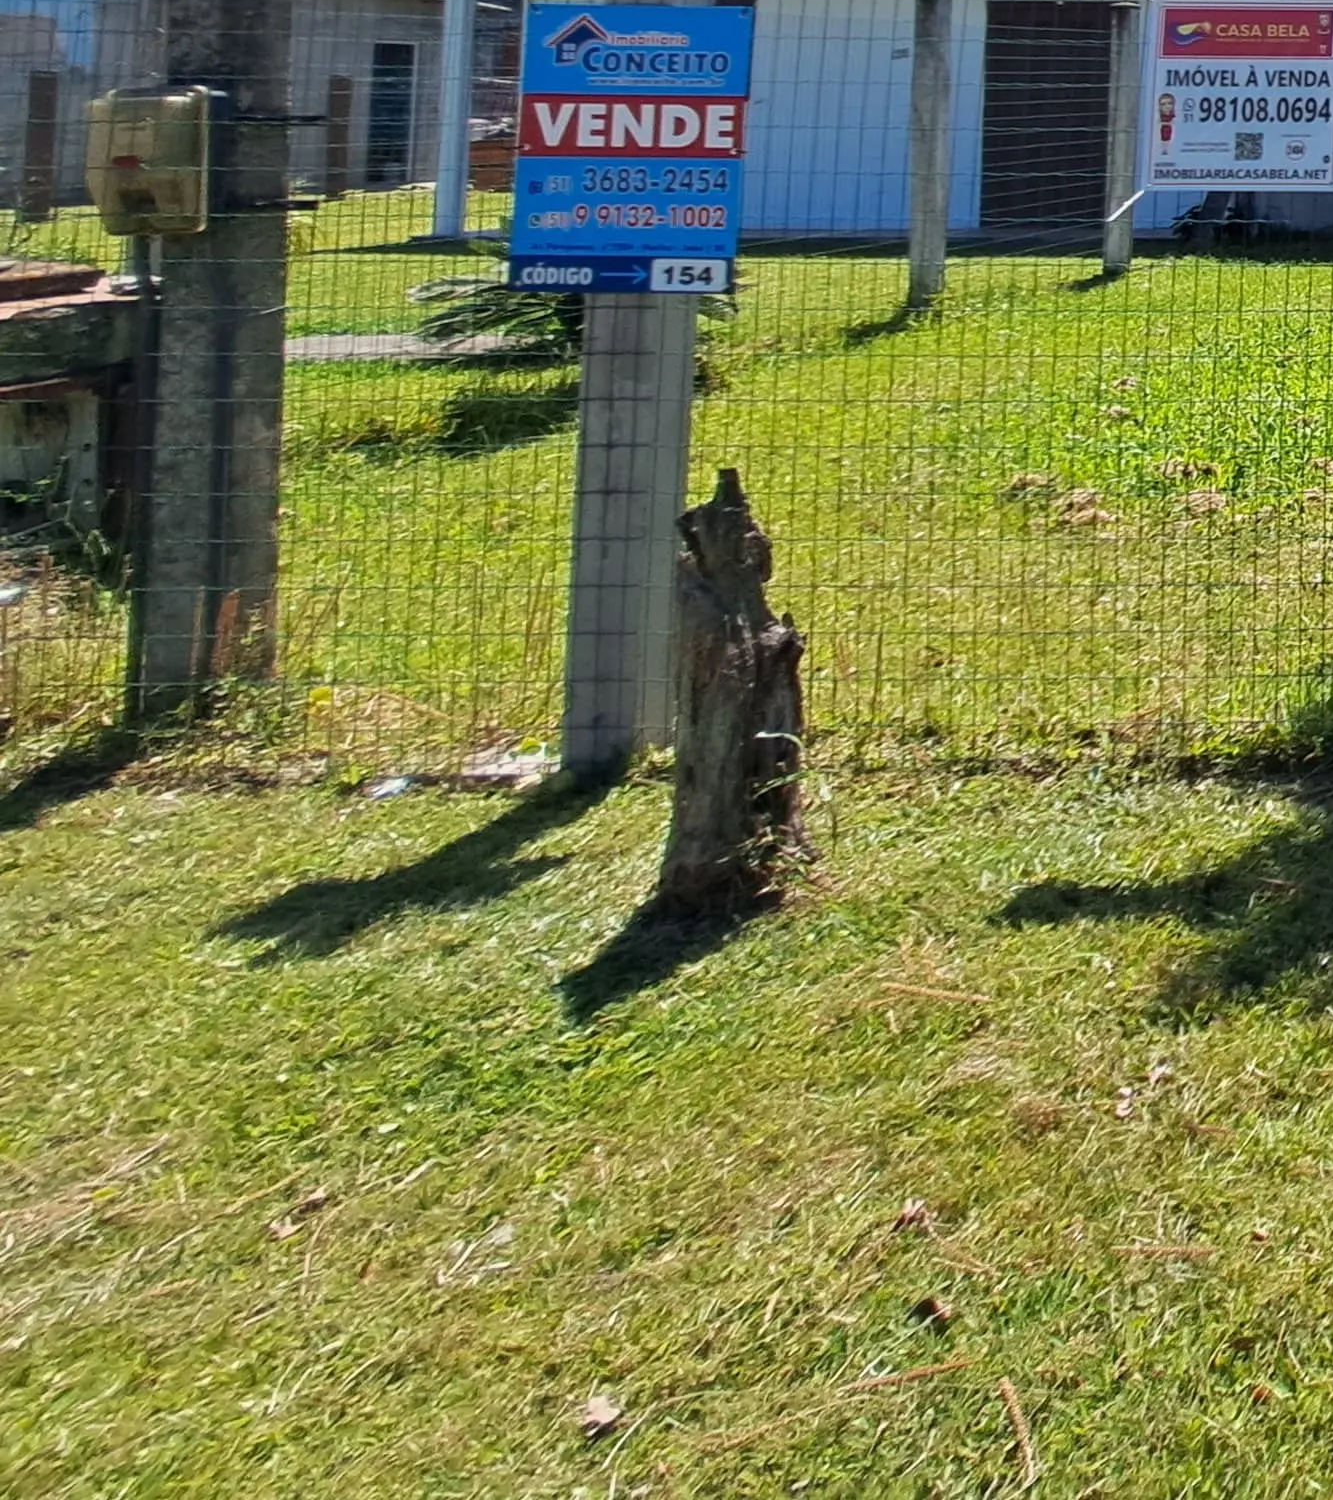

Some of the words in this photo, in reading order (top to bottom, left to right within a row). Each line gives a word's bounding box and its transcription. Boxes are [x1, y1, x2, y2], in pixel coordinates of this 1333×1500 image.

[1215, 23, 1262, 37] CASA
[1267, 23, 1310, 37] BELA
[582, 47, 729, 74] CONCEITO
[1165, 65, 1240, 88] IMÓVEL
[1245, 65, 1259, 88] À
[1265, 70, 1331, 88] VENDA
[1199, 97, 1332, 123] 98108.0694
[534, 102, 736, 149] VENDE
[582, 167, 729, 194] 3683-2454
[1153, 168, 1329, 181] IMOBILIARIACASABELA.NET
[574, 205, 589, 226] 9
[597, 205, 727, 228] 9132-1002
[521, 261, 593, 285] CÓDIGO
[663, 266, 714, 286] 154
